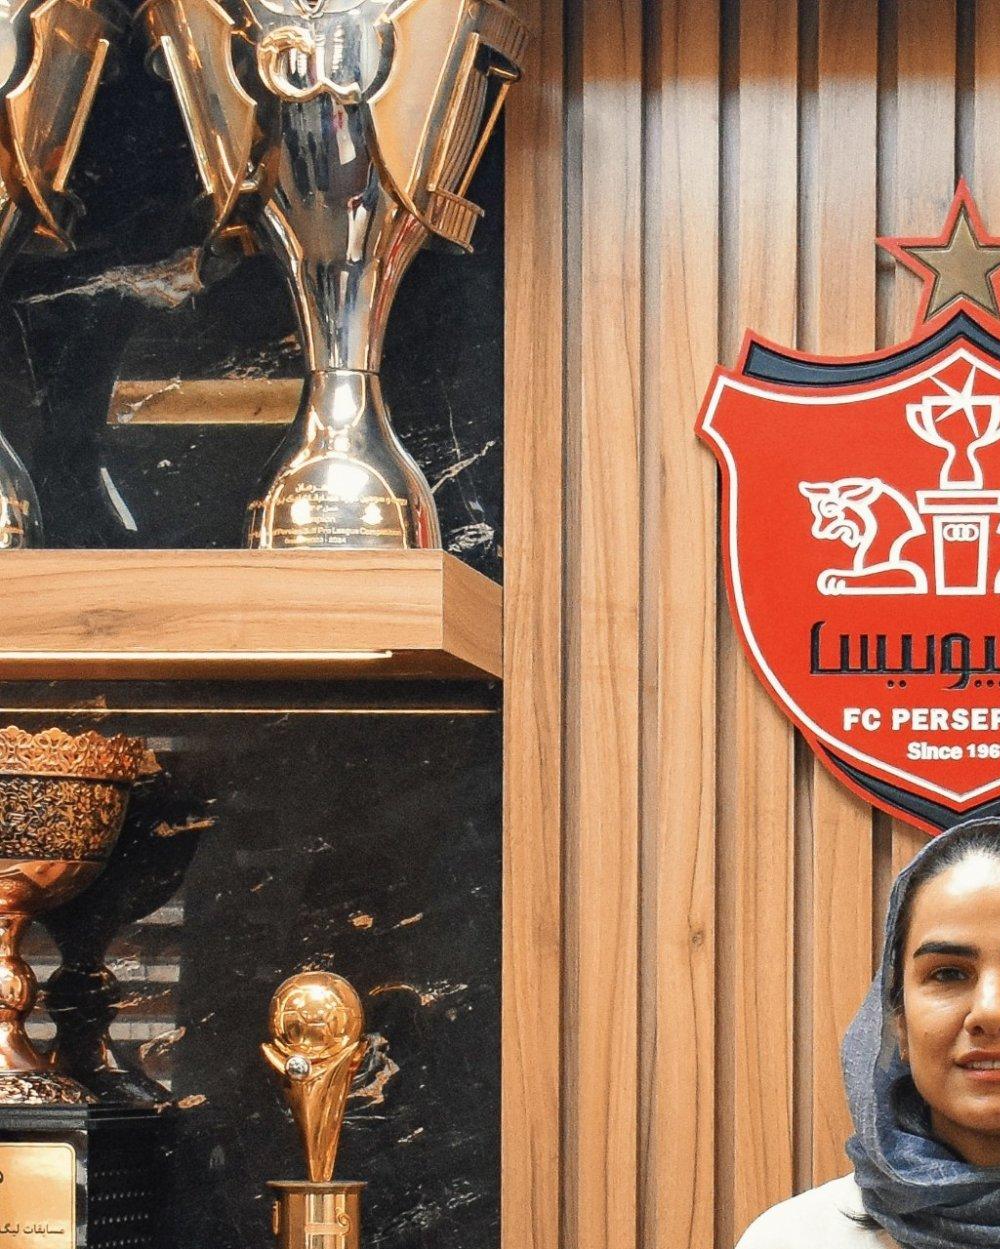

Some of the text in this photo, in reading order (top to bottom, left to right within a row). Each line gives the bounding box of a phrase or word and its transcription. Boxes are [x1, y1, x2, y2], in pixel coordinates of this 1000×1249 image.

[843, 707, 881, 731] FC
[907, 740, 963, 760] Since
[22, 1223, 65, 1236] مسابقات
